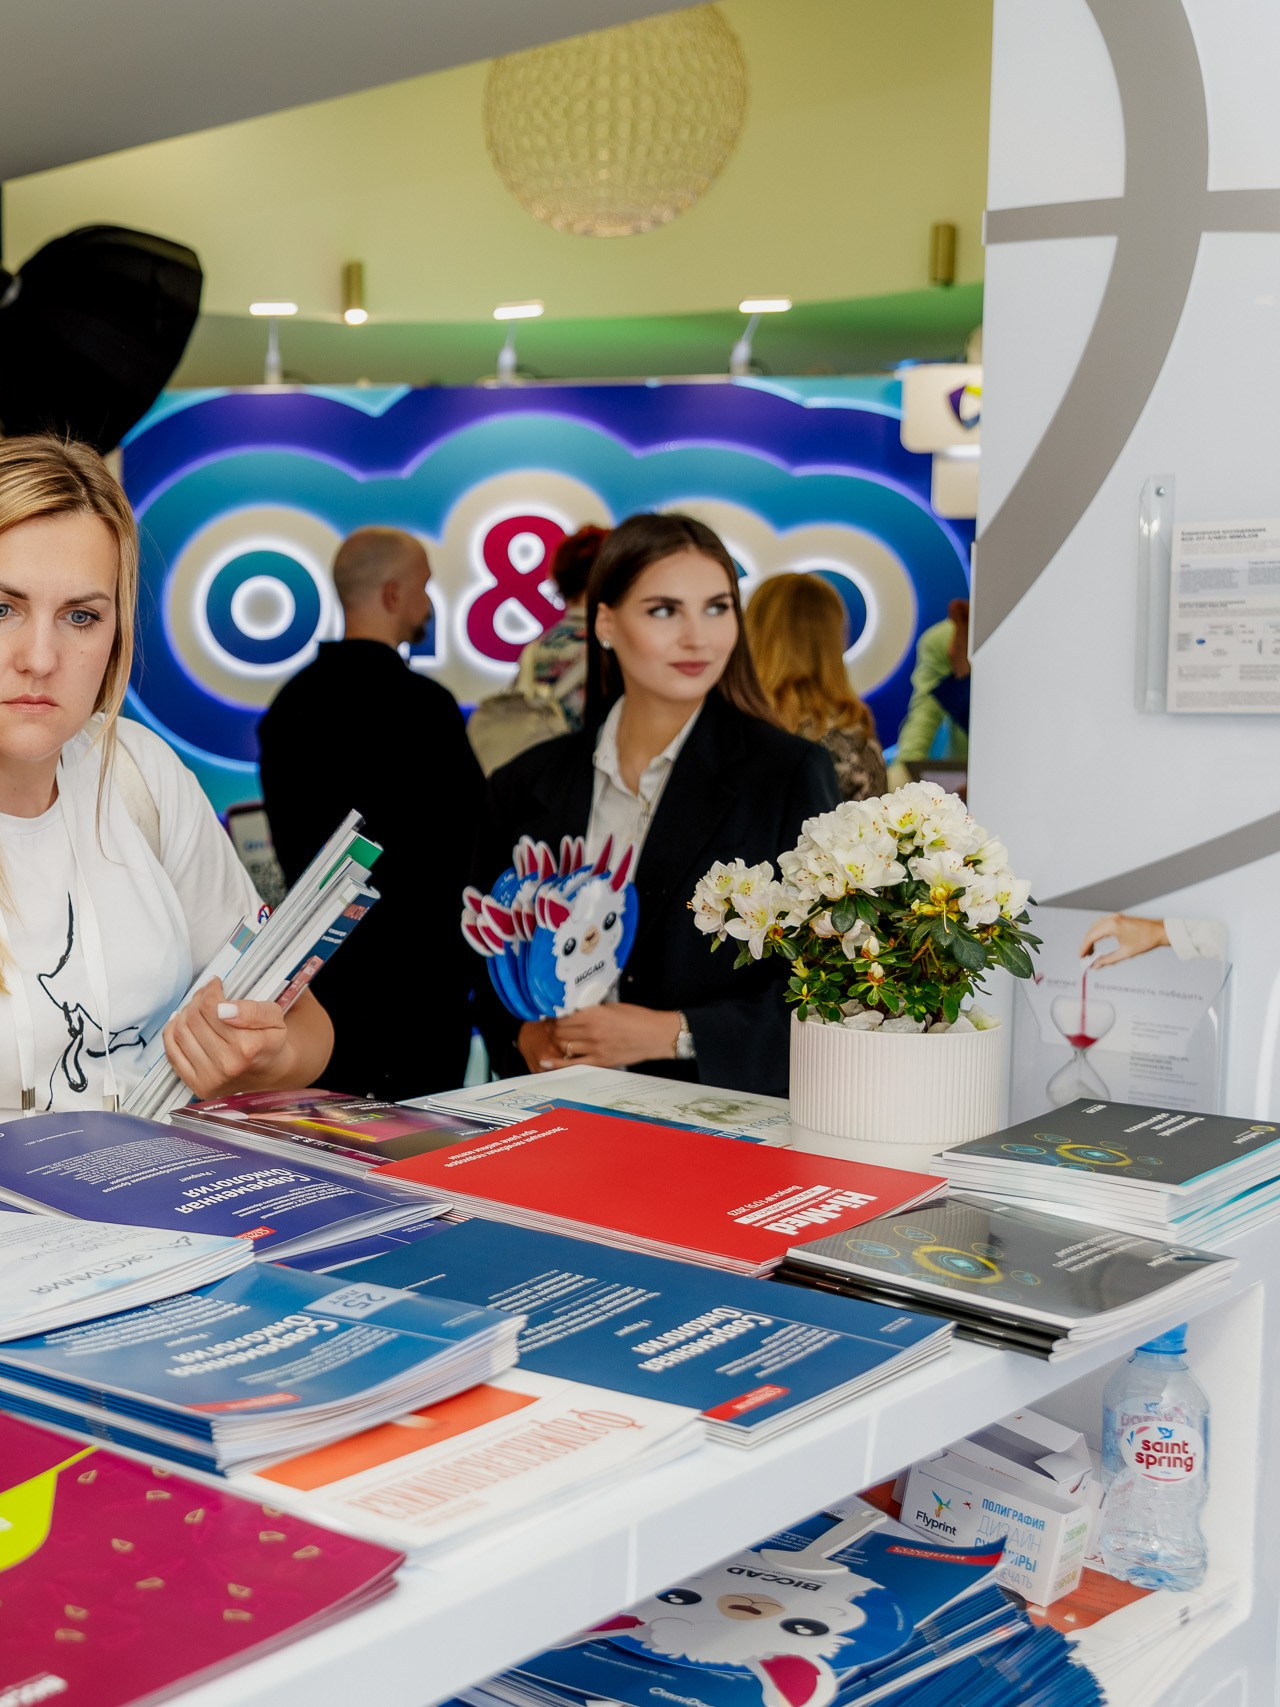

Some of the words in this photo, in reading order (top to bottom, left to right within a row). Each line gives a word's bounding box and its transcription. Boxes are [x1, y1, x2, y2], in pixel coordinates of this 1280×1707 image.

[171, 1173, 313, 1213] Современная
[178, 1167, 291, 1198] Онкология
[326, 1285, 360, 1304] лет
[336, 1289, 386, 1312] 25
[165, 1314, 339, 1375] Современная
[169, 1309, 310, 1364] Онкология
[630, 1304, 744, 1357] Онкология
[636, 1308, 771, 1373] Современная
[1135, 1451, 1193, 1472] spring
[1141, 1439, 1189, 1455] saint
[915, 1510, 957, 1537] Flyprint
[981, 1498, 1046, 1531] ПОЛИГРАФИЯ
[977, 1515, 1042, 1554] ДИЗАЙН
